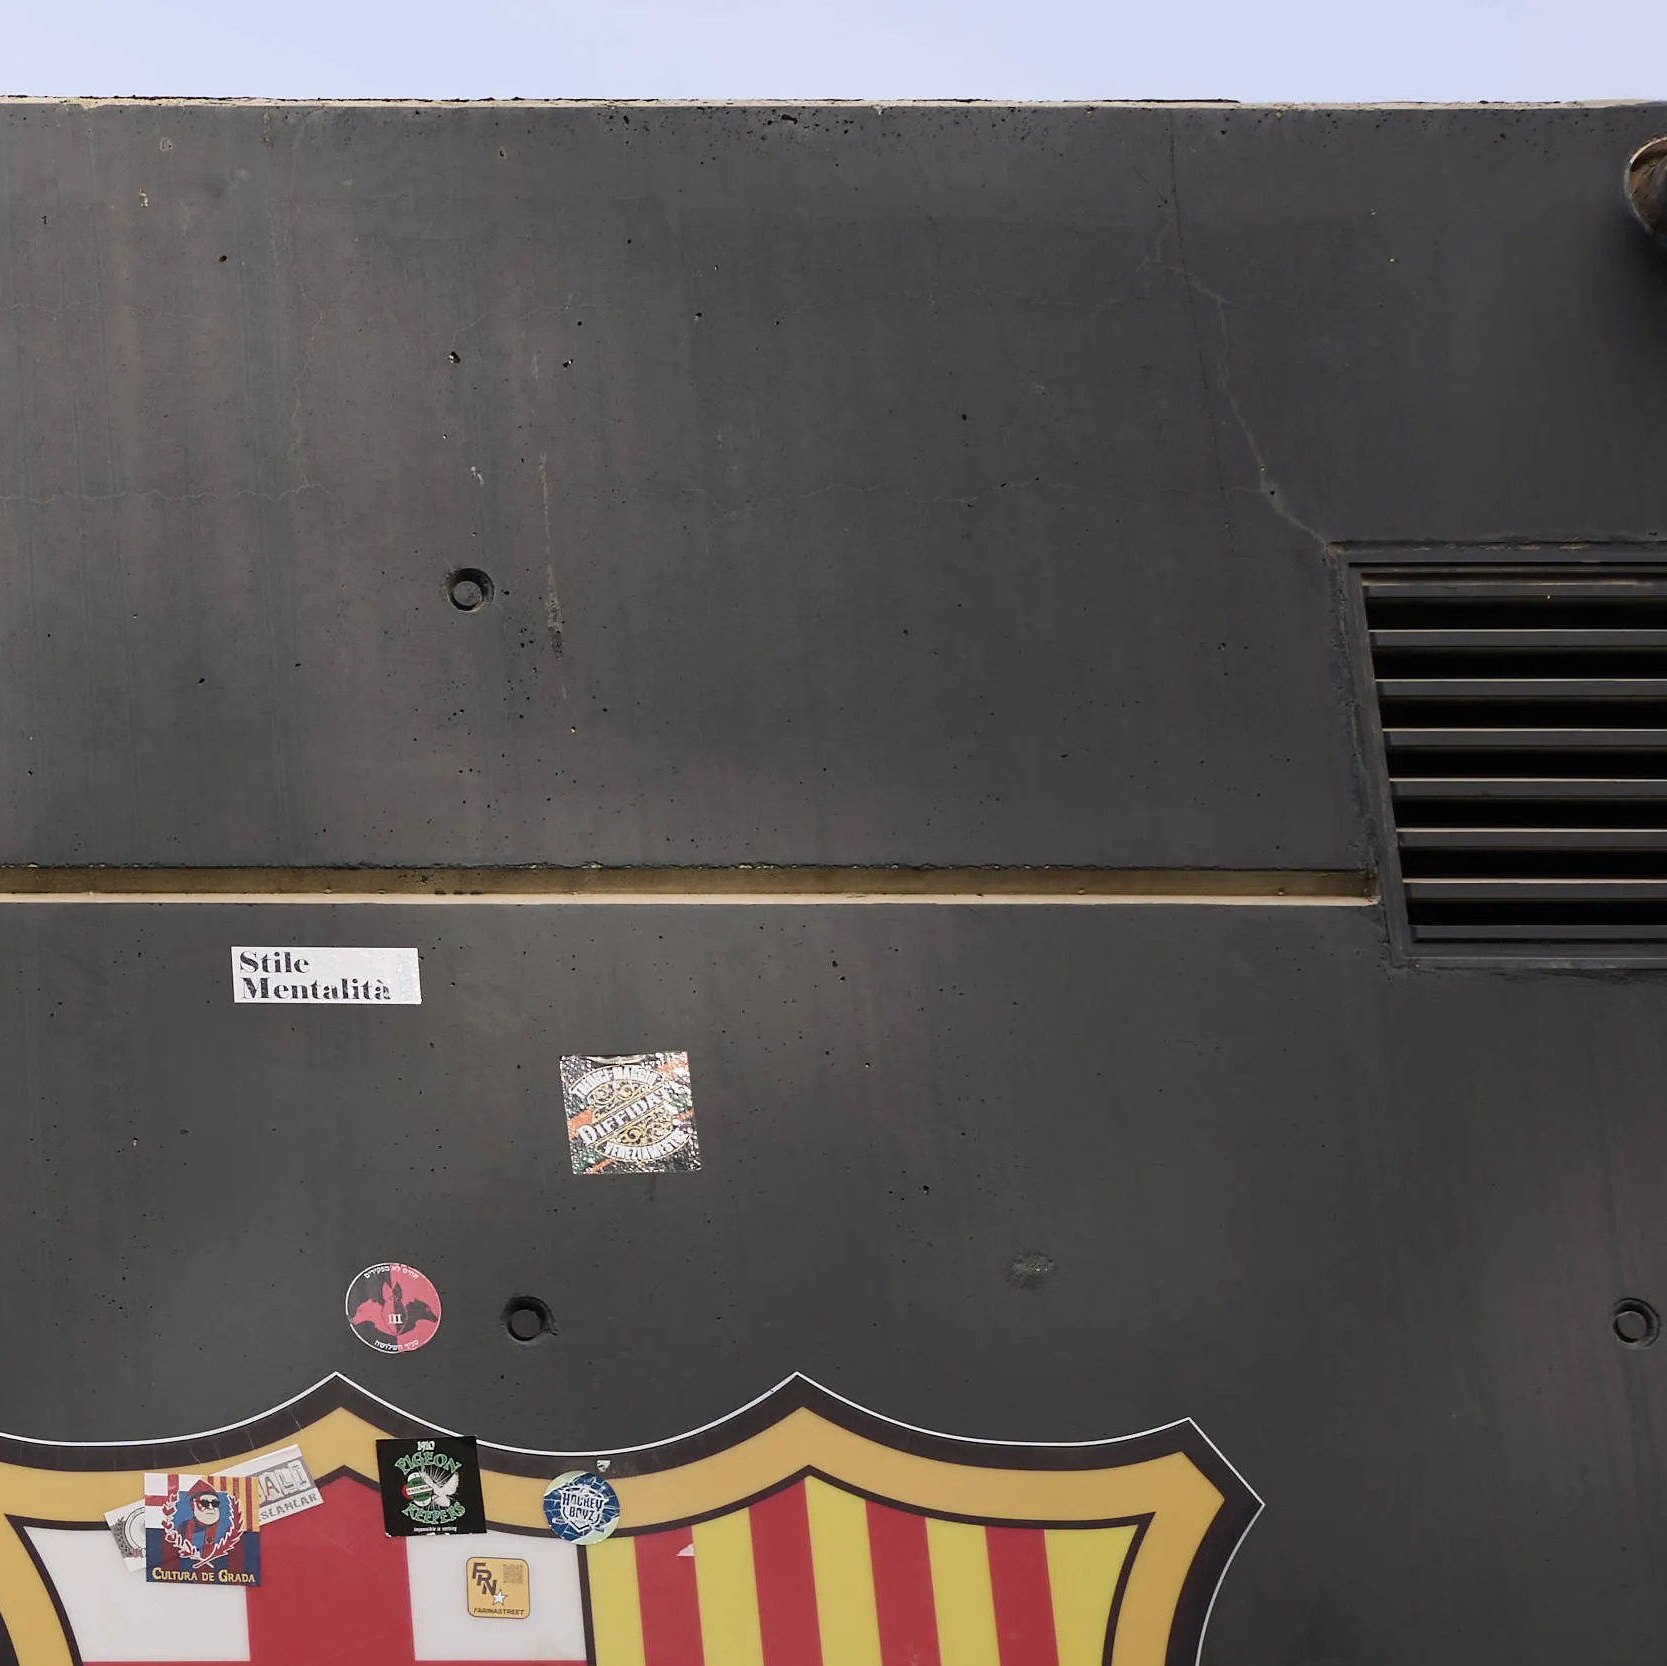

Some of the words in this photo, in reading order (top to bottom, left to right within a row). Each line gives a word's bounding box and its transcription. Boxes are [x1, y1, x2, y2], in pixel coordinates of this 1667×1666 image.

[239, 950, 310, 974] Stile
[242, 977, 391, 1000] Mentalità
[388, 1314, 403, 1324] III
[395, 1451, 462, 1476] PIGEON
[259, 1463, 308, 1498] ALI
[401, 1501, 466, 1525] KEEPERS
[562, 1492, 604, 1512] HOCKEY
[569, 1506, 595, 1522] BOYZ
[152, 1567, 198, 1582] CULTURA
[201, 1572, 215, 1582] DE
[218, 1569, 256, 1583] GRADA
[472, 1562, 498, 1596] FRN
